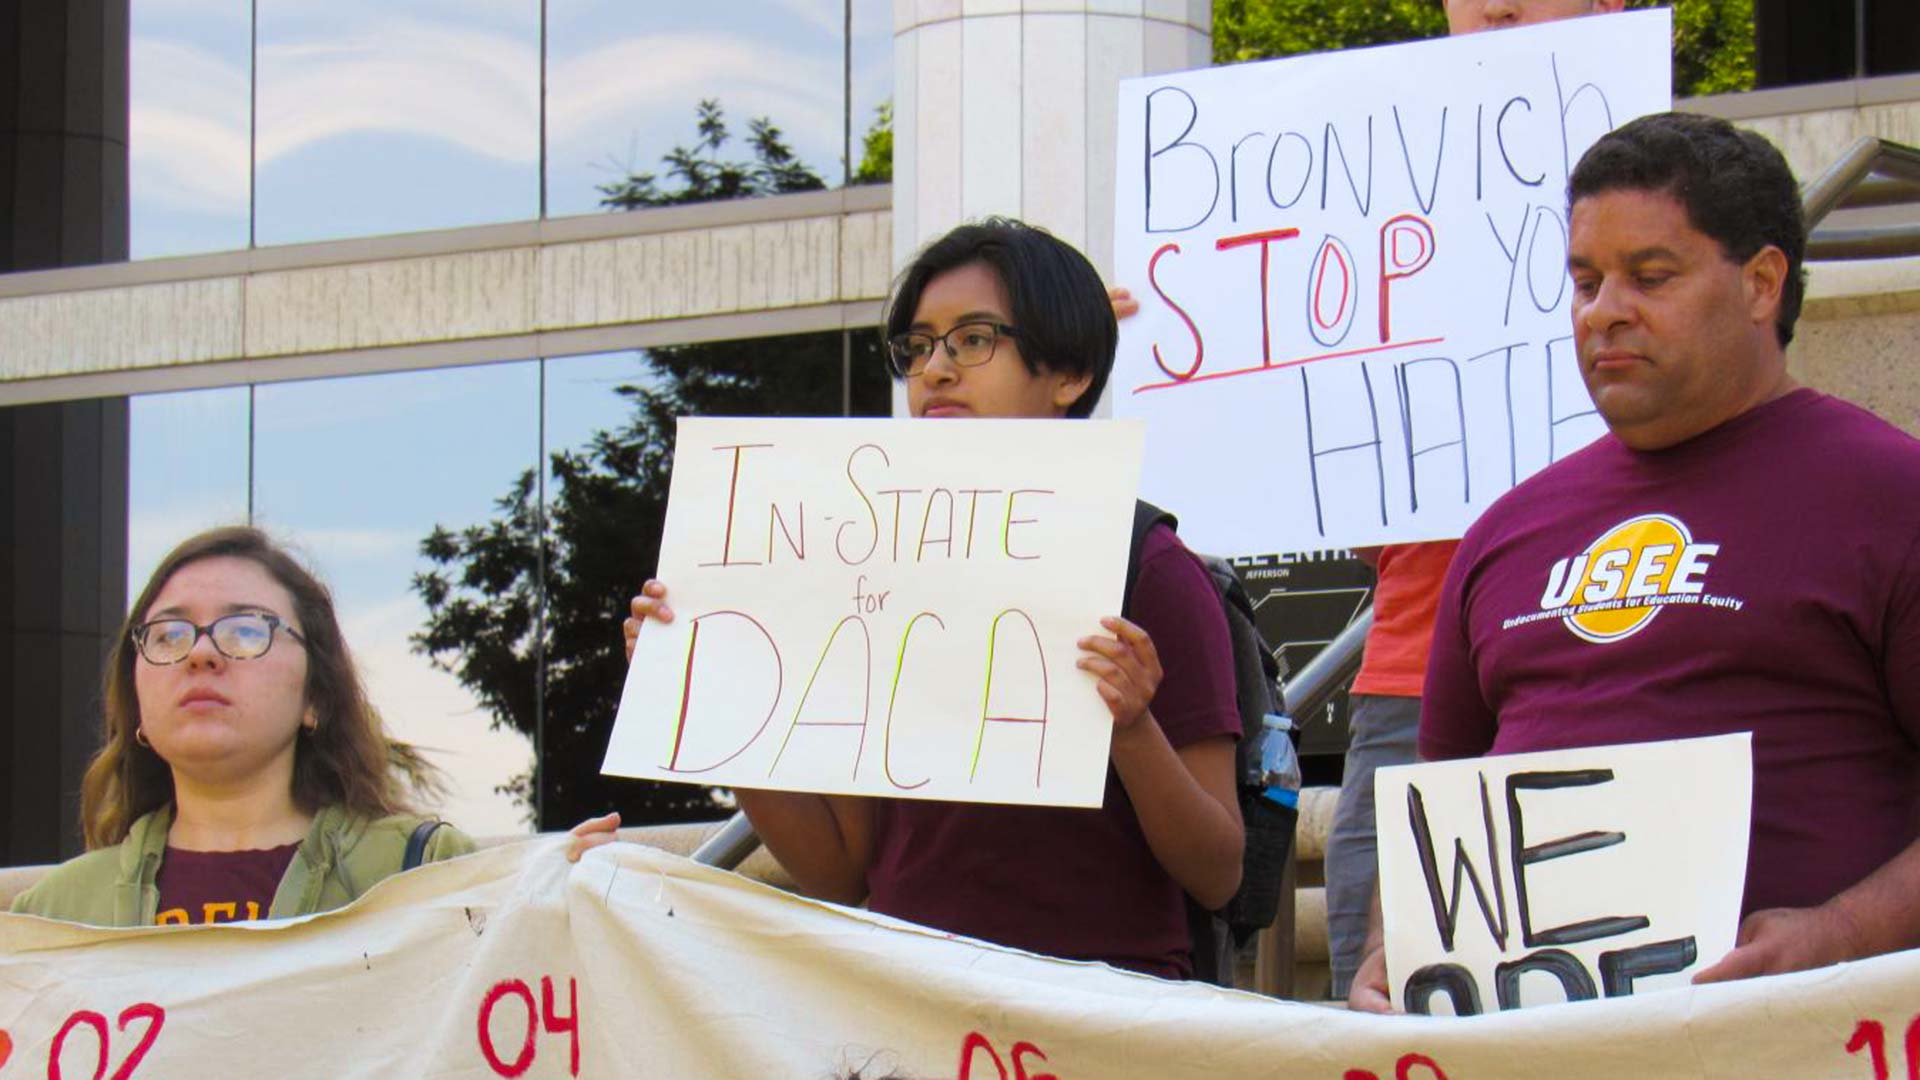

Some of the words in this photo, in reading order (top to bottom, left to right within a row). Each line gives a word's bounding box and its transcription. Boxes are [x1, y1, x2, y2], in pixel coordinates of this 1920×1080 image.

[1148, 214, 1436, 382] STOP
[698, 444, 1056, 567] IN-STATE
[852, 575, 891, 616] for
[1245, 568, 1290, 580] JEFFERSON
[1502, 605, 1575, 629] Undocumented
[1577, 599, 1624, 614] Students
[1642, 592, 1700, 607] Education
[1701, 594, 1744, 611] Equity
[1541, 544, 1720, 610] USEE
[657, 608, 1049, 790] DACA
[1407, 768, 1651, 953] WE
[477, 975, 580, 1079] 04
